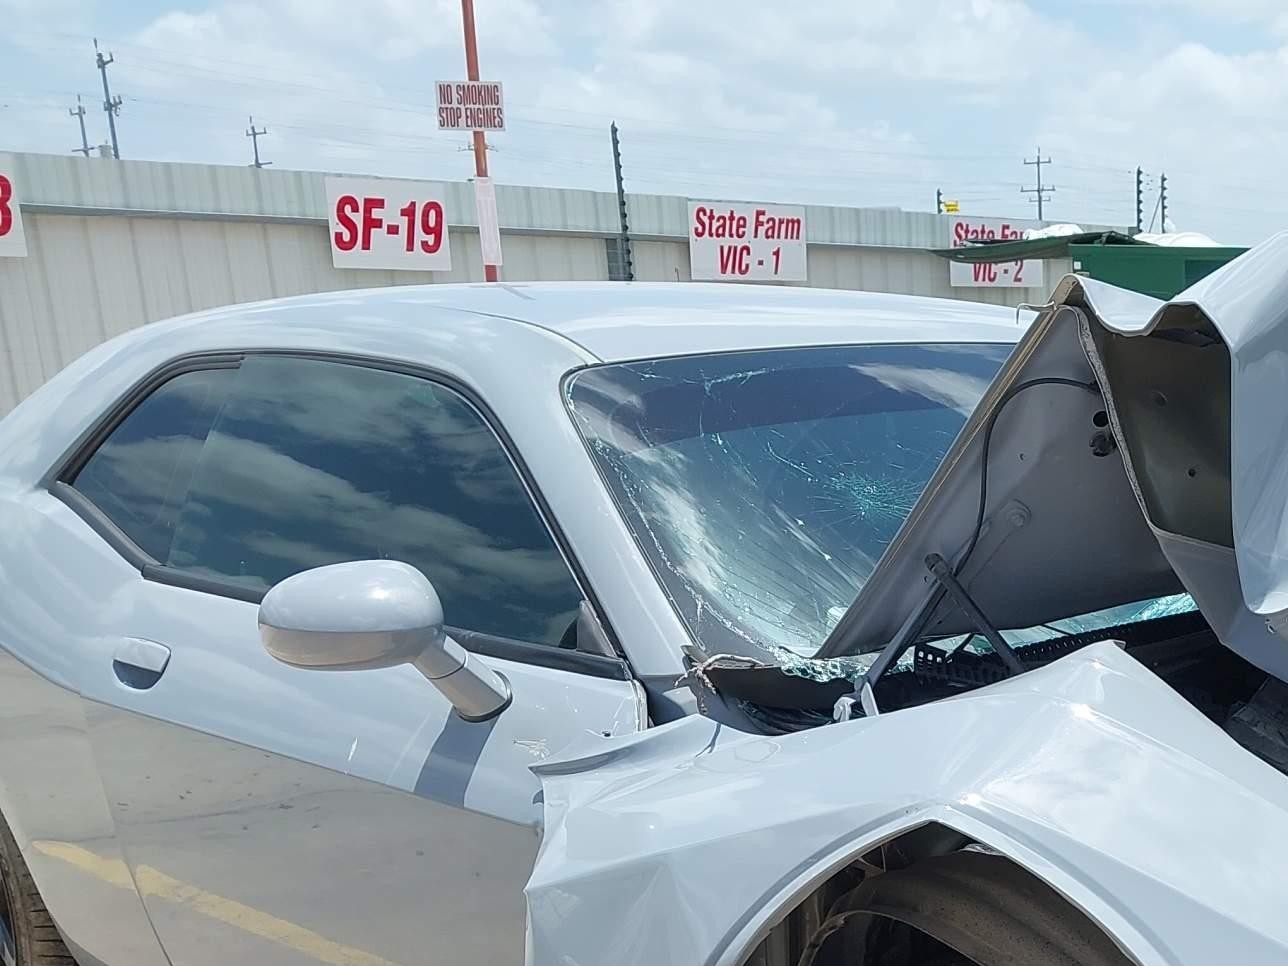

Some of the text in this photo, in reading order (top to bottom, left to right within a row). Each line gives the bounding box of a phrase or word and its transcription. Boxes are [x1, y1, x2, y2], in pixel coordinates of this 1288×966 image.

[438, 84, 500, 106] NO SMOKING
[438, 107, 504, 129] STOP ENGINES
[334, 195, 443, 254] SF-19
[694, 206, 801, 240] State Farm
[719, 245, 751, 275] VIC
[772, 246, 781, 275] 1
[1013, 259, 1024, 282] 2
